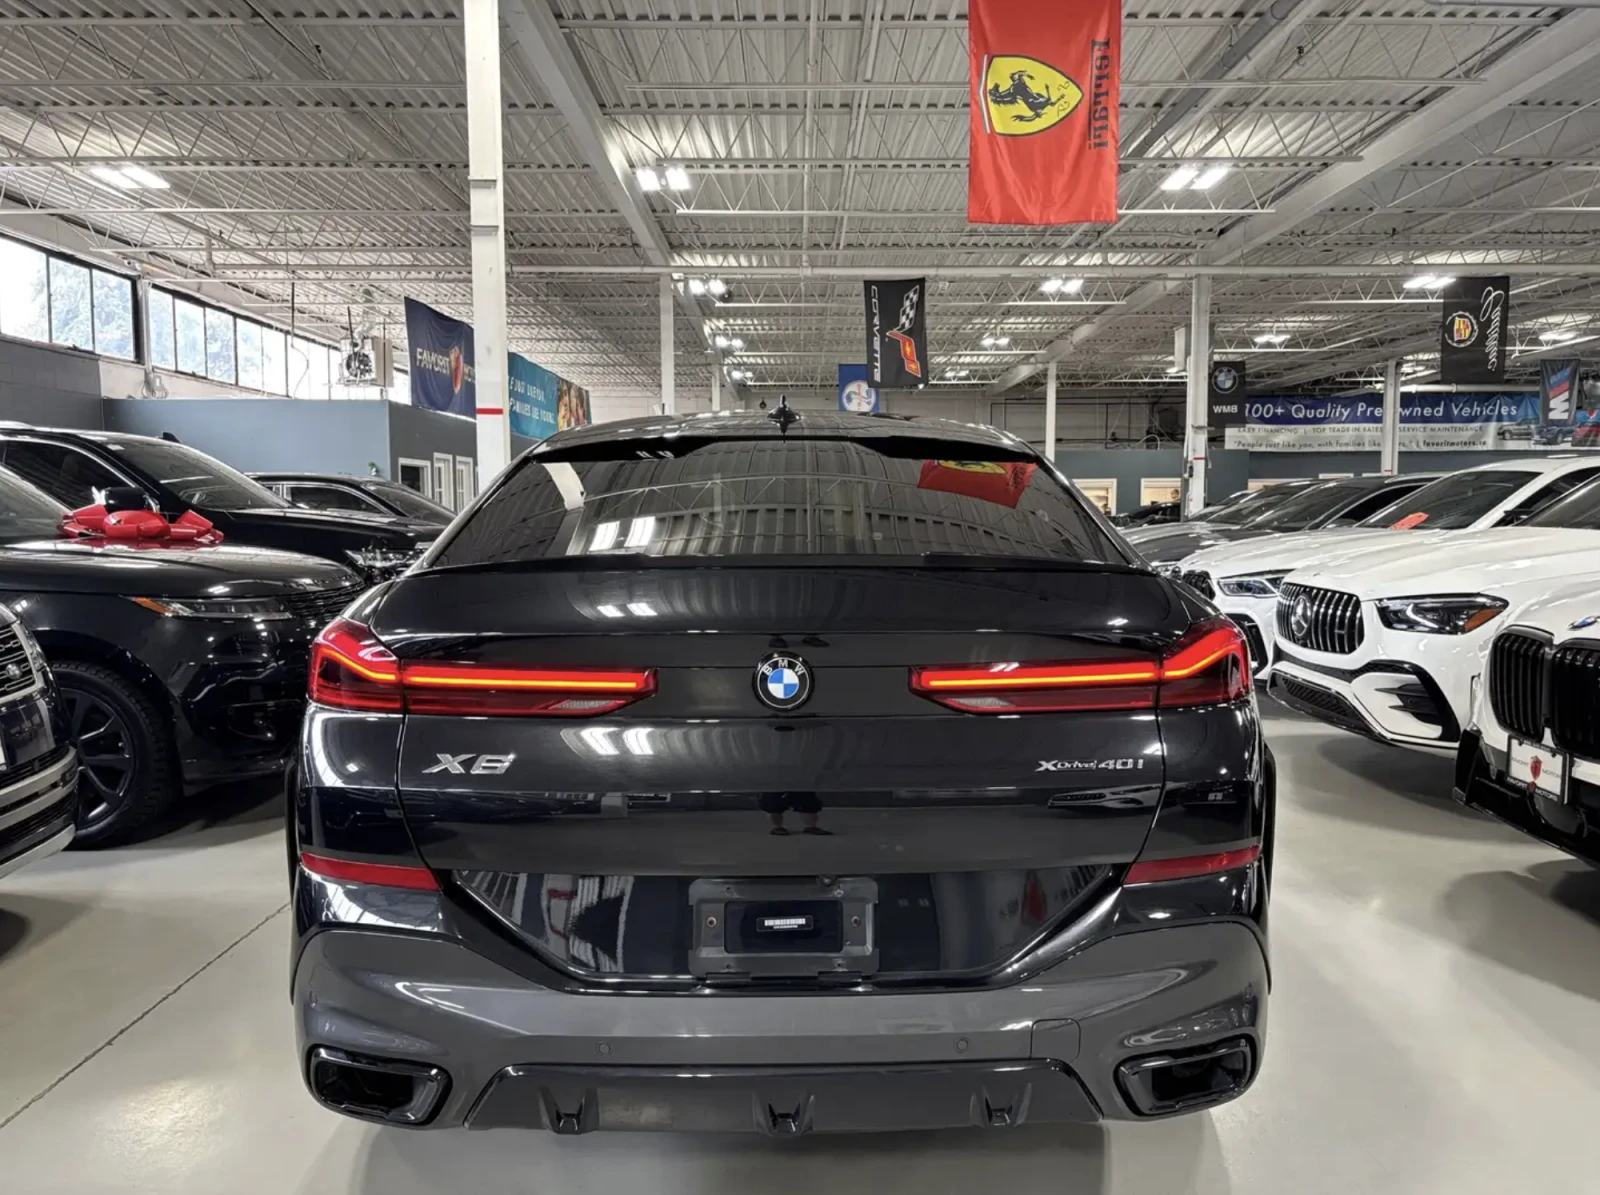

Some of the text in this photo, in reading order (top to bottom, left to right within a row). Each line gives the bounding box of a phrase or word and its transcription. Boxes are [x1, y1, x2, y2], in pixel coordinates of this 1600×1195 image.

[871, 285, 881, 383] CORVETTE
[416, 347, 450, 375] FAVORIT
[1245, 403, 1285, 418] 100+
[1292, 402, 1351, 421] Quality
[1451, 399, 1517, 417] Vehicles
[761, 659, 806, 676] BMW
[421, 753, 515, 775] X6
